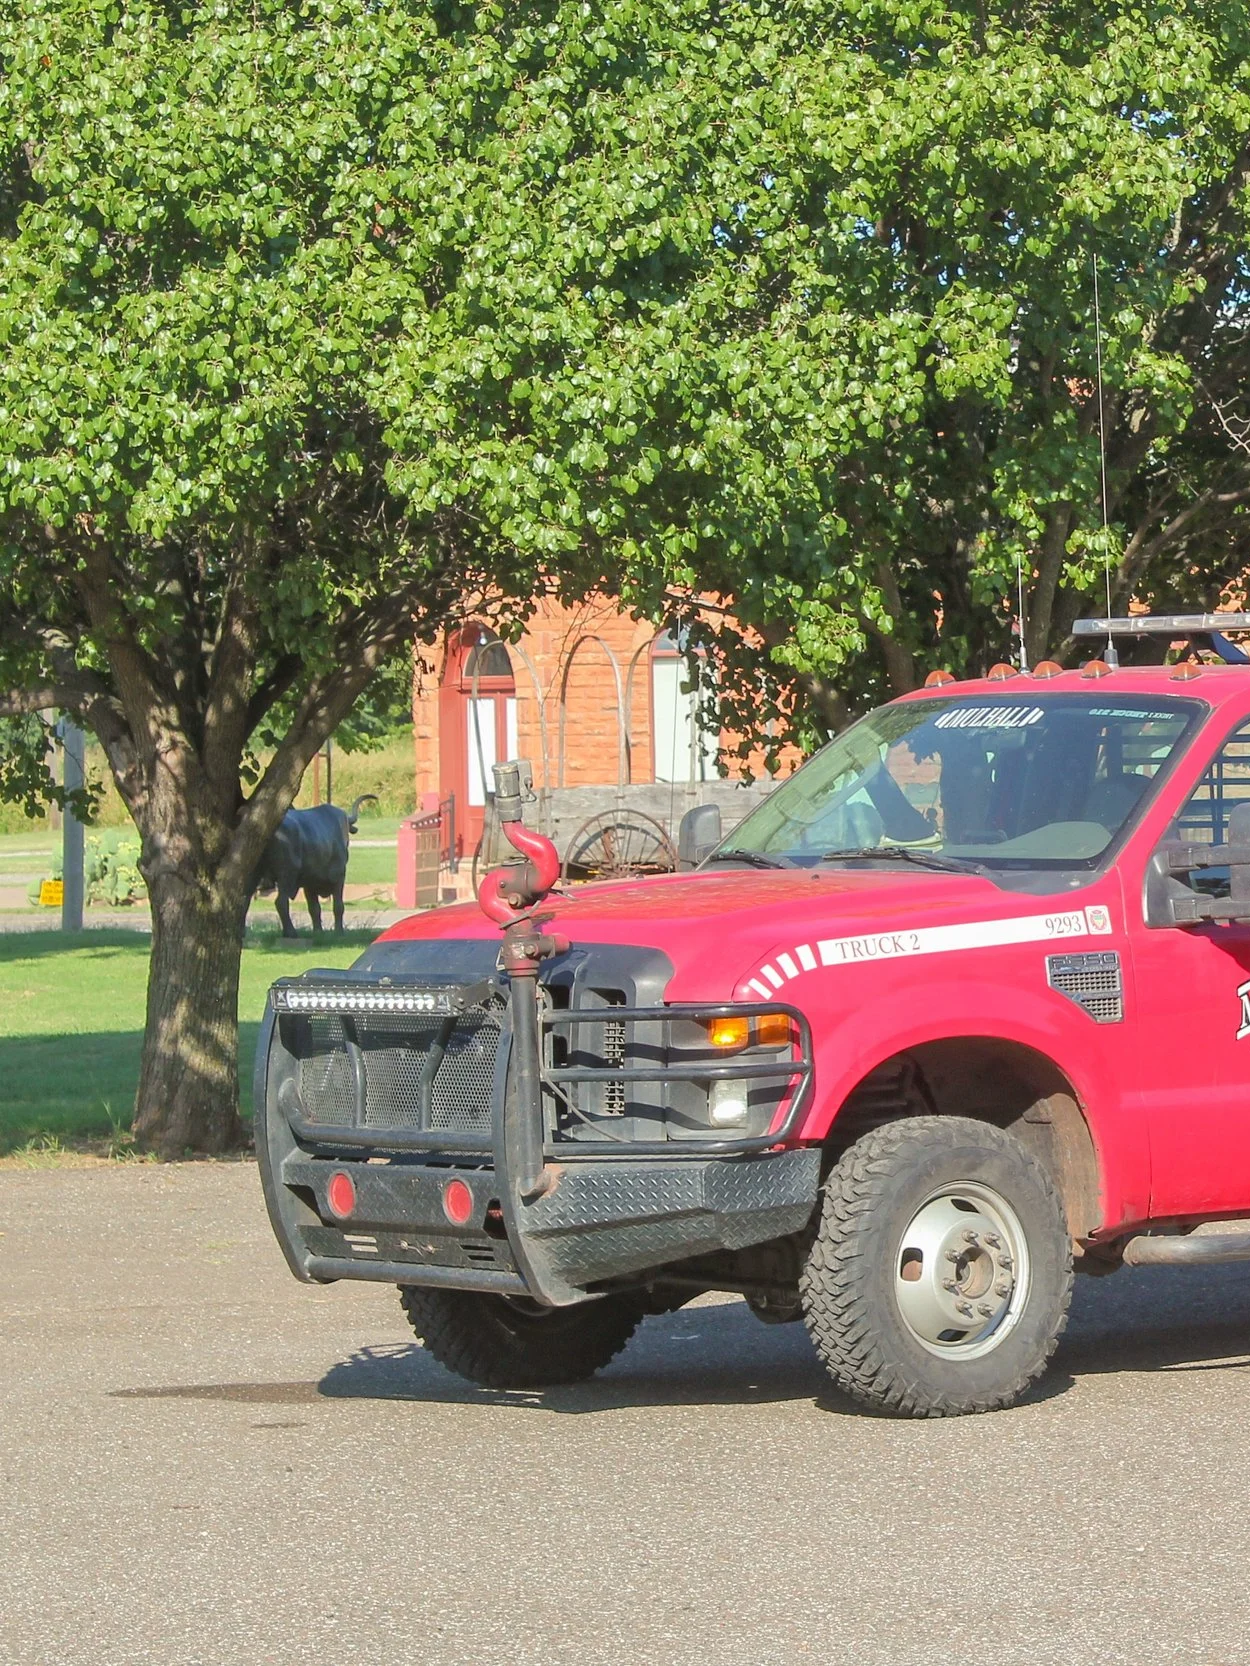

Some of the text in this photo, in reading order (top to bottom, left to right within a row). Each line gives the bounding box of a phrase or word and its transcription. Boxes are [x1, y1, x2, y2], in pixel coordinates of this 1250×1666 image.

[942, 707, 1029, 728] MULHALL
[1045, 914, 1082, 936] 9293
[835, 933, 921, 959] TRUCK 2
